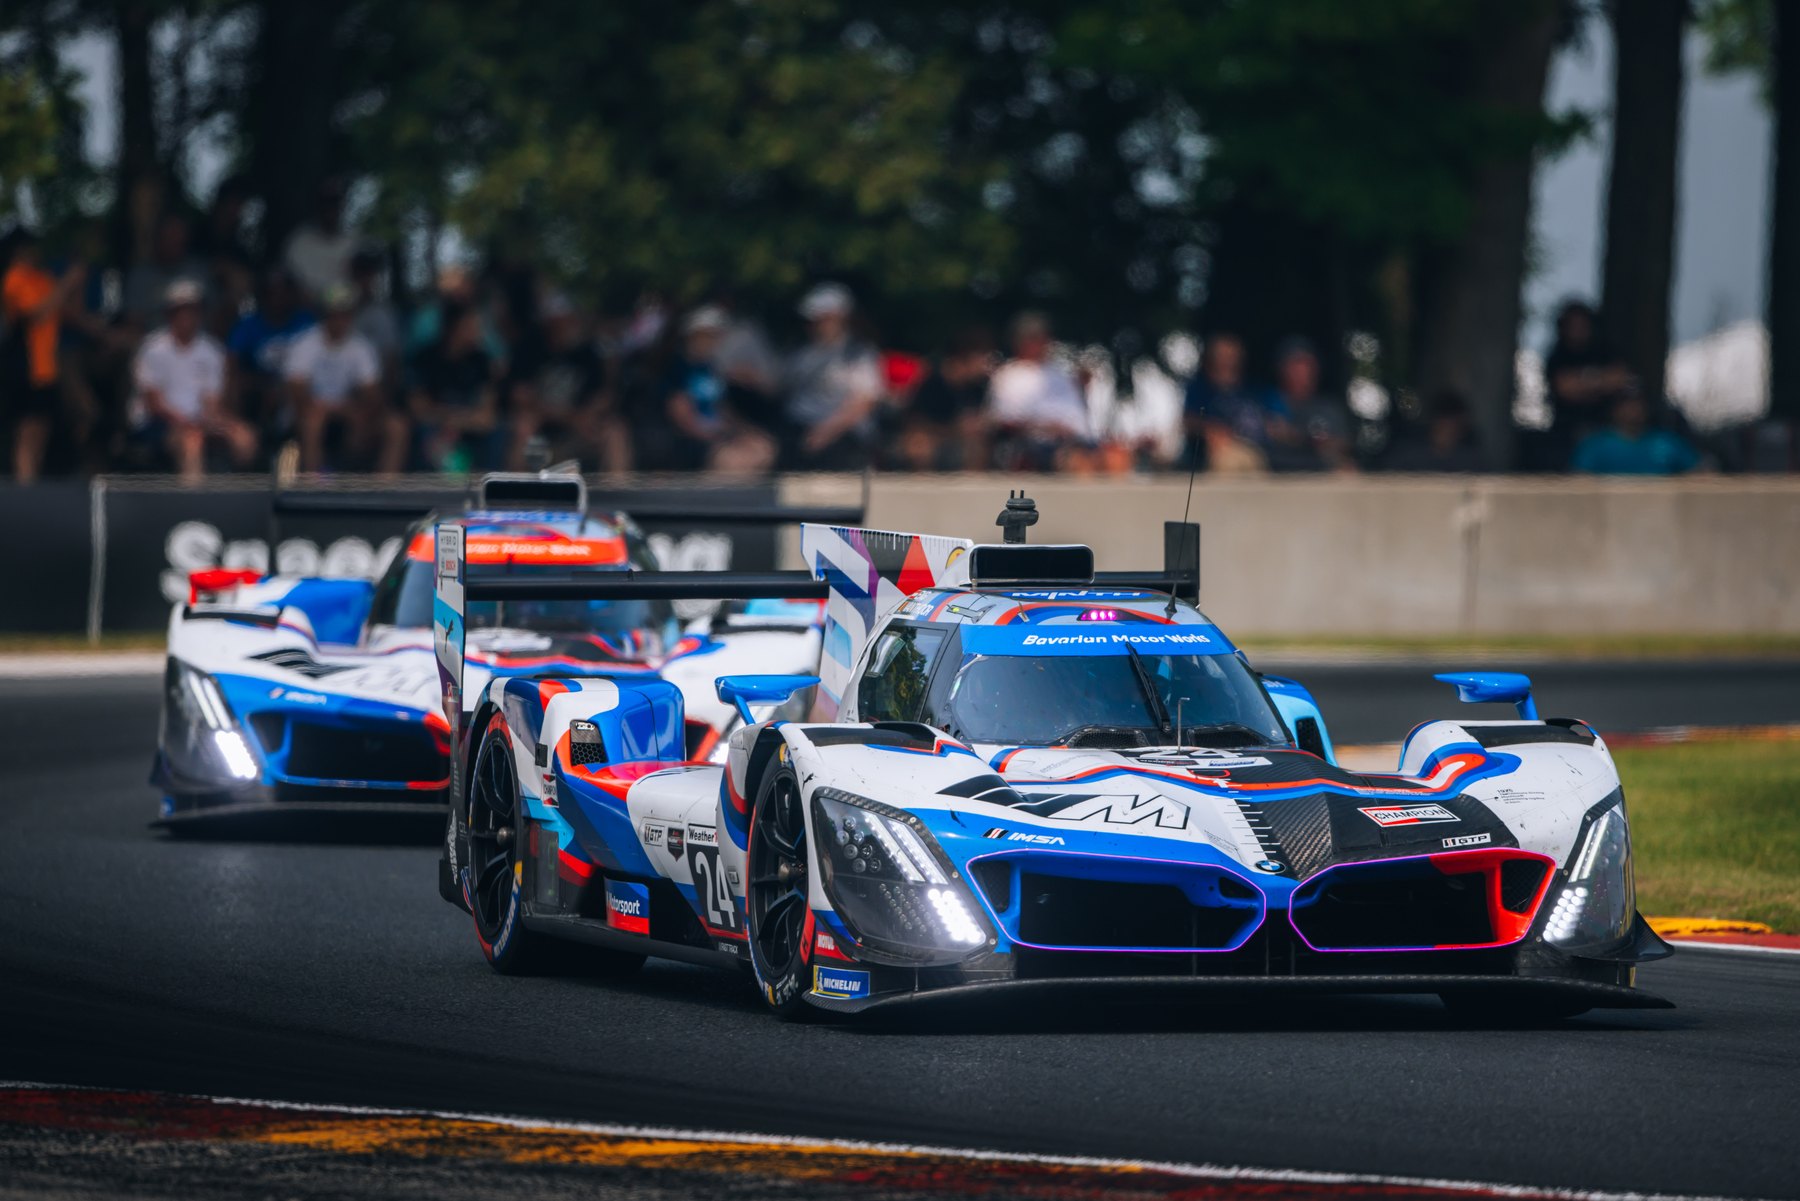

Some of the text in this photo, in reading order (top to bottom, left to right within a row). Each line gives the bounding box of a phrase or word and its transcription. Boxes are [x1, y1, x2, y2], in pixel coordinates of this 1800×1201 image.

[1022, 634, 1211, 646] Bavarian Motor Works
[1374, 808, 1446, 820] CHAMPION
[650, 829, 662, 842] GTP
[1008, 832, 1066, 846] IMSA
[1458, 835, 1488, 844] GTP
[695, 852, 735, 928] 24
[824, 978, 861, 992] MICHELIN
